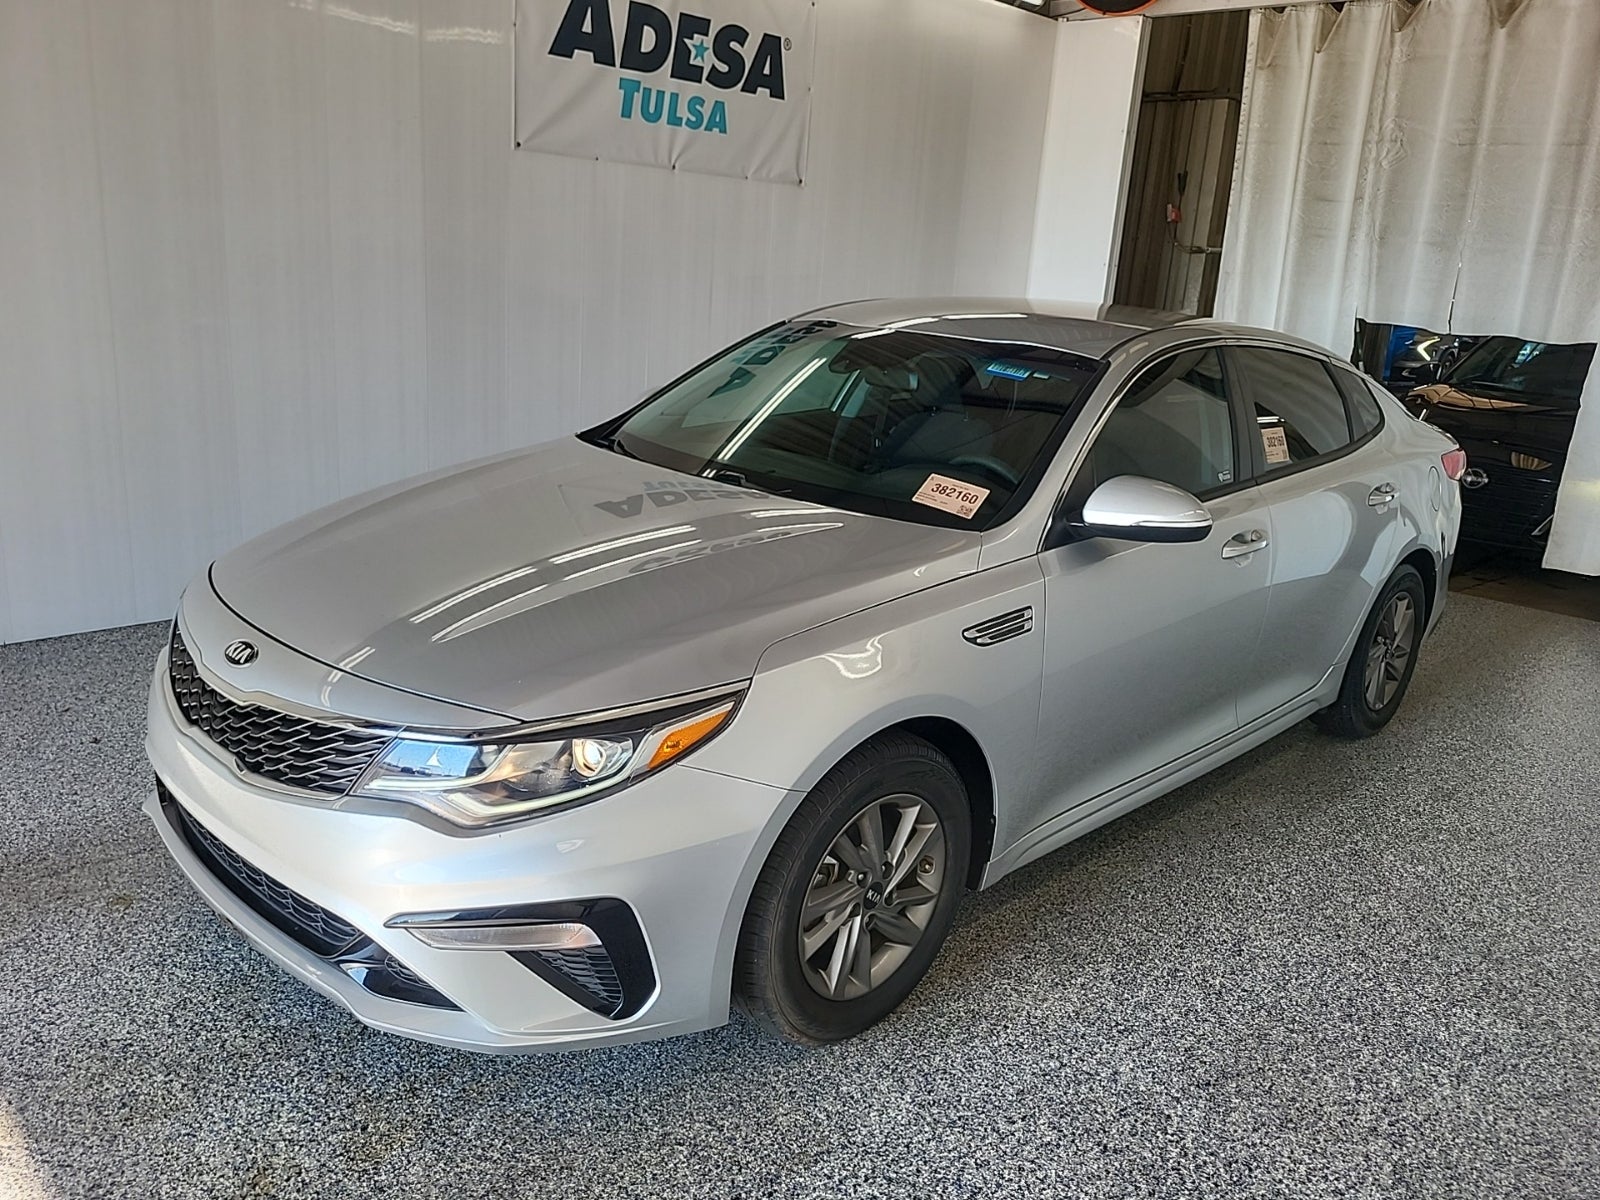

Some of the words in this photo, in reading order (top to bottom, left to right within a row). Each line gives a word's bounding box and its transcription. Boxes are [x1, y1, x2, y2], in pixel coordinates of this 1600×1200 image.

[548, 0, 786, 100] ADESA
[931, 483, 979, 505] 382160
[226, 641, 252, 664] KIA
[866, 889, 881, 904] KIA
